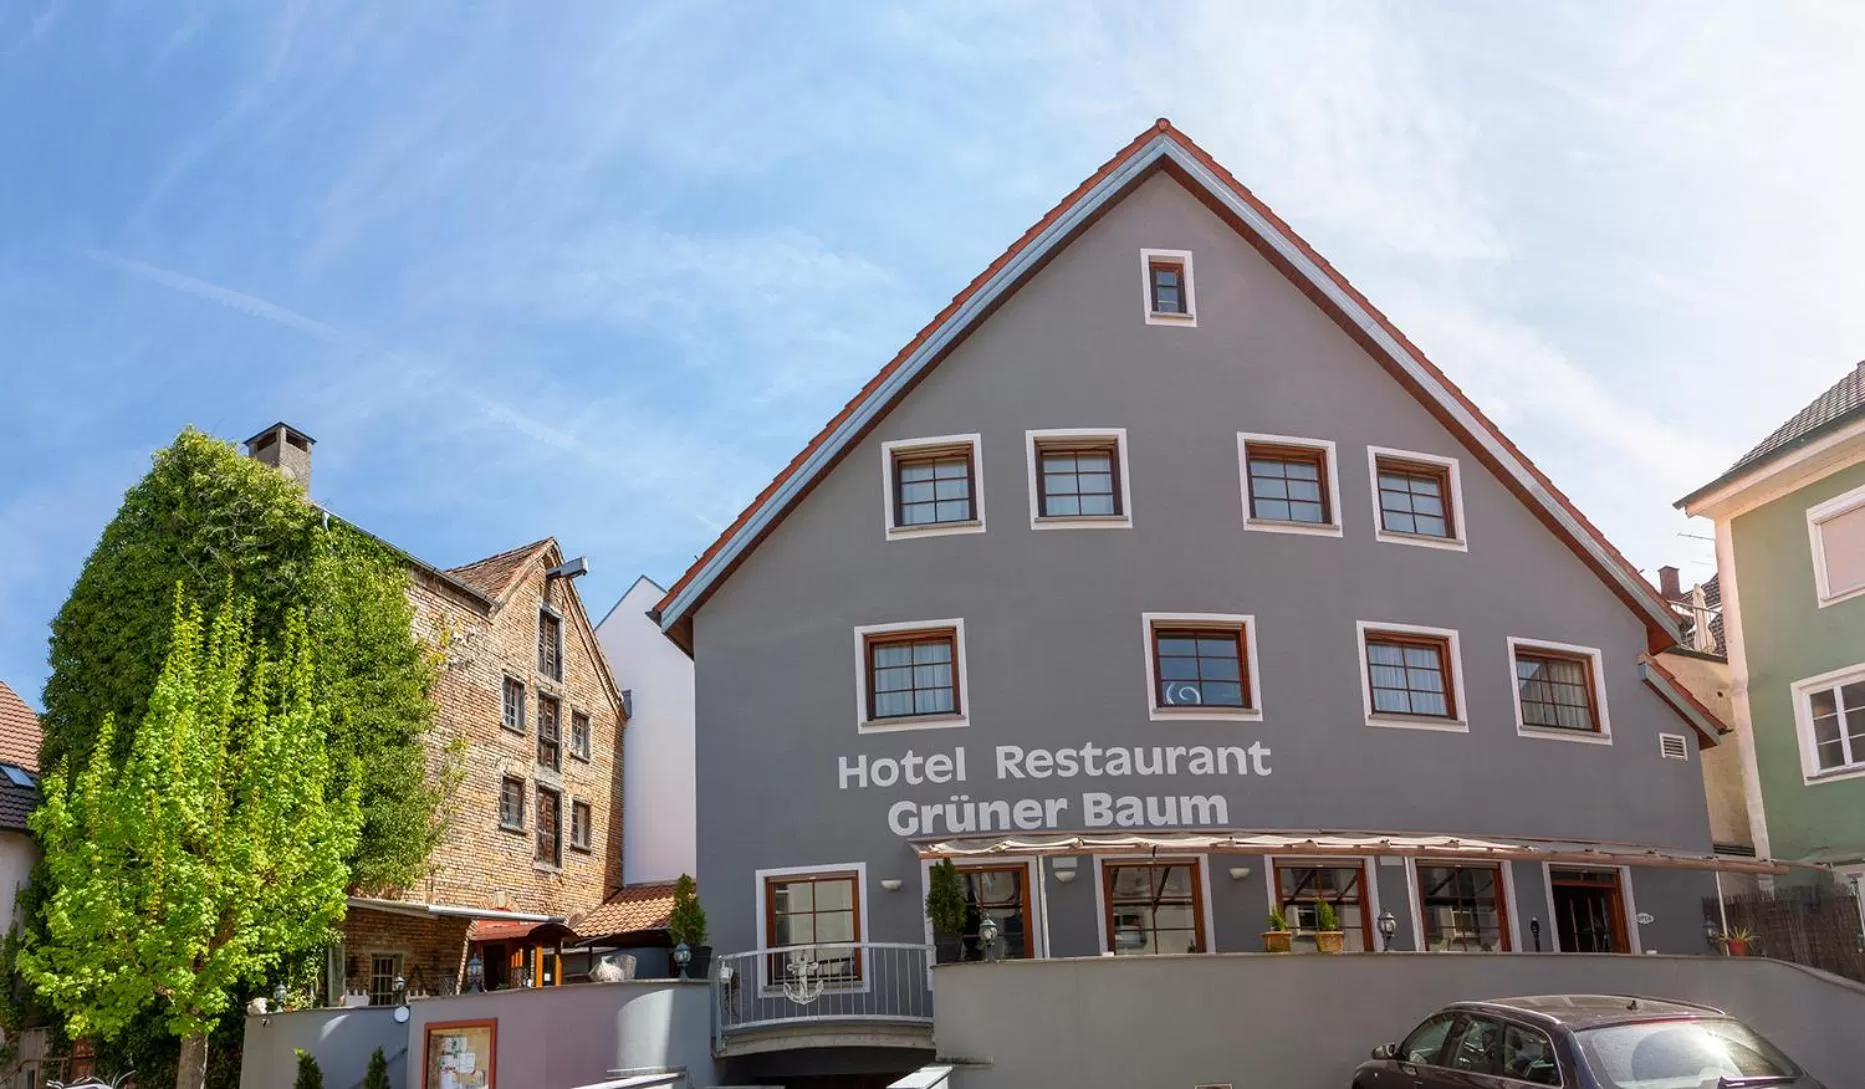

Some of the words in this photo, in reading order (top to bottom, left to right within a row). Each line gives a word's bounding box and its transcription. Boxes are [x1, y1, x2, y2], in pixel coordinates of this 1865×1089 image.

[838, 746, 967, 789] Hotel
[995, 740, 1273, 780] Restaurant
[887, 794, 1068, 837] Grüner
[1082, 792, 1229, 827] Baum
